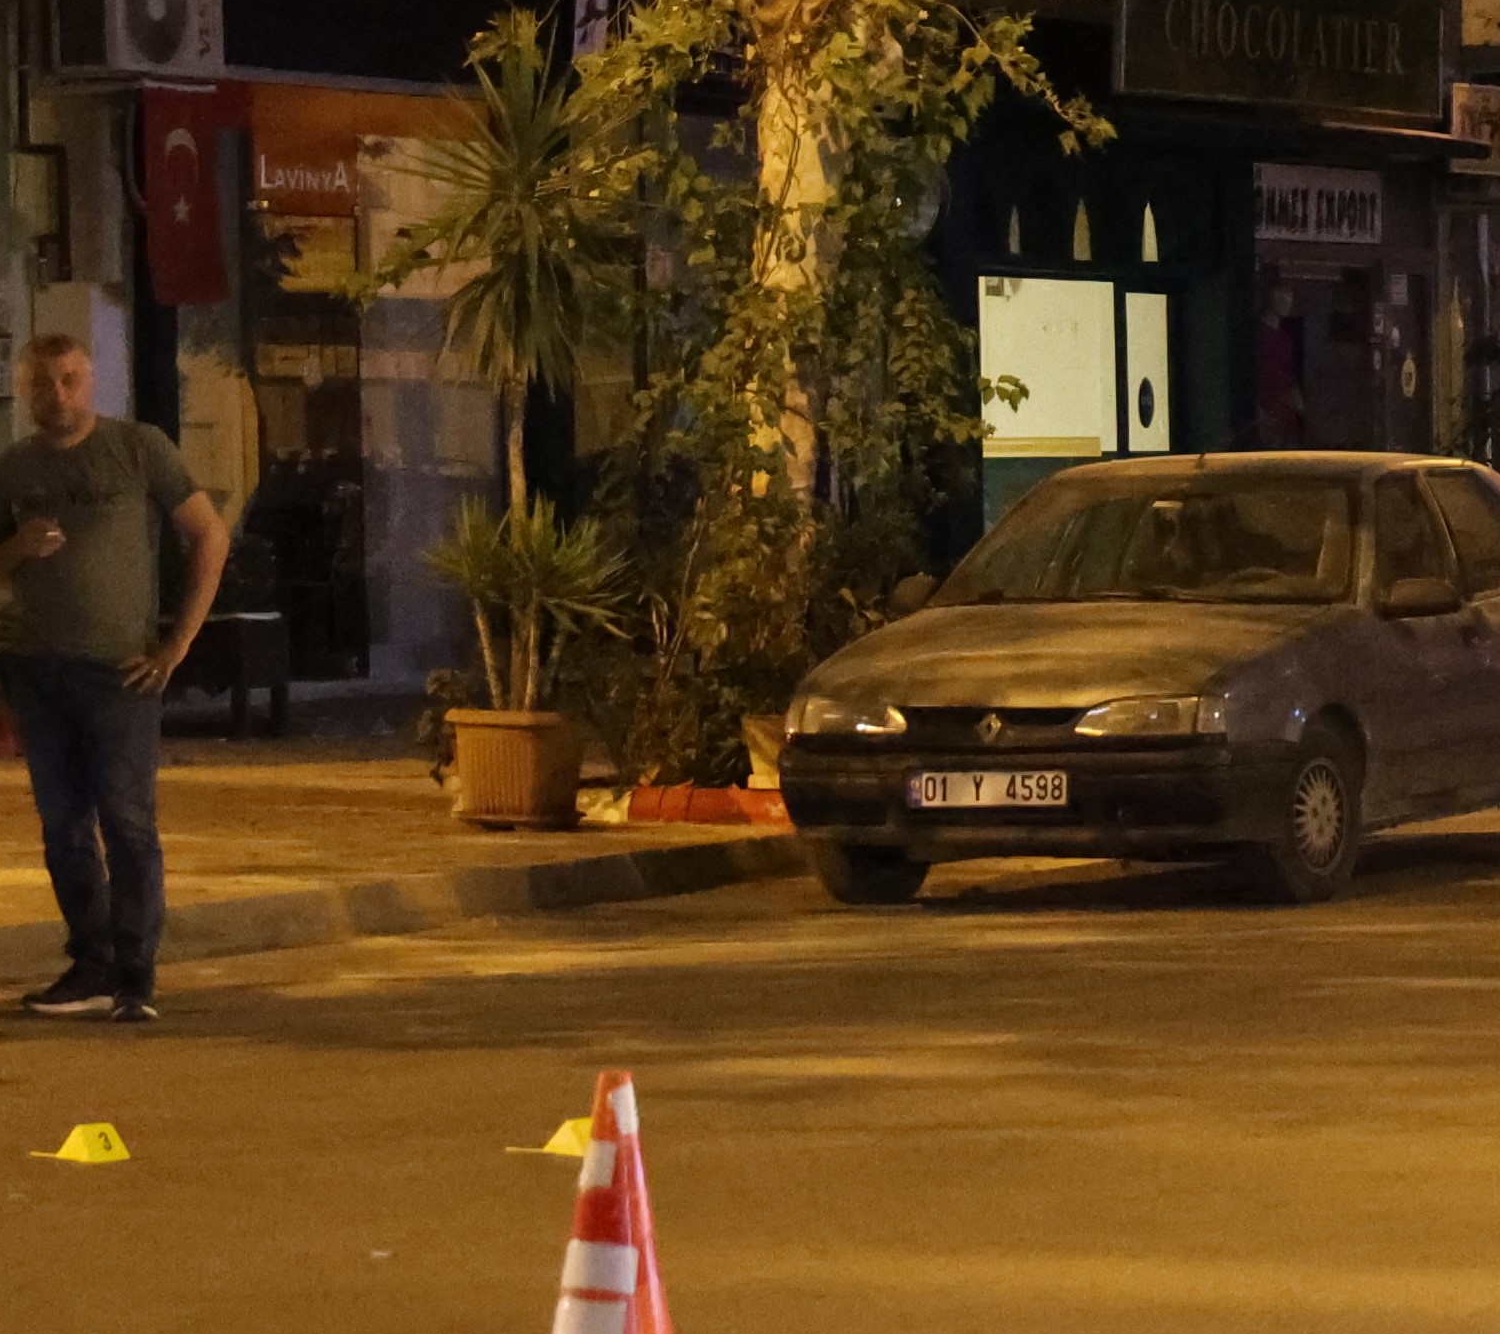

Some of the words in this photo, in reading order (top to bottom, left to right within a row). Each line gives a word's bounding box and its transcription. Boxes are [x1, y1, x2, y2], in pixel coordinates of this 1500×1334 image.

[924, 775, 948, 802] 01
[972, 774, 984, 802] Y
[1006, 774, 1063, 801] 4598
